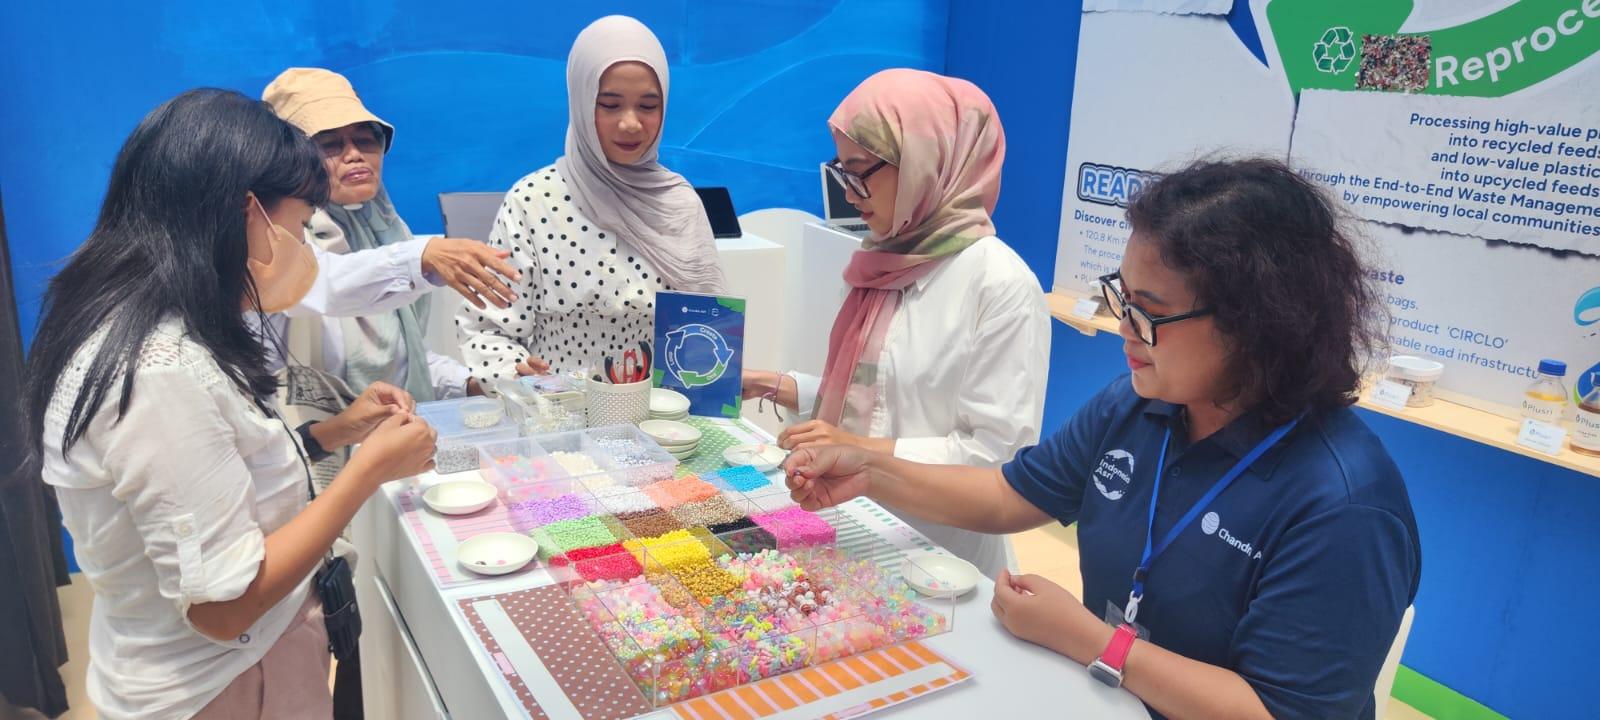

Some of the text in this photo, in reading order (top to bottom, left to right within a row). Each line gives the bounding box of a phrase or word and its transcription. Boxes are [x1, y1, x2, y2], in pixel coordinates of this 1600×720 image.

[1410, 113, 1490, 134] Processing
[1494, 118, 1582, 137] high-value
[1449, 133, 1478, 148] into
[1482, 140, 1553, 155] recycled
[1431, 152, 1600, 178] and low-value plastic
[1082, 171, 1148, 200] READ
[1440, 168, 1600, 197] into upcycled feeds
[1349, 175, 1370, 188] the
[1374, 178, 1454, 198] End-to-End
[1458, 187, 1506, 204] Waste
[1510, 194, 1600, 217] Manageme
[1074, 209, 1117, 227] Discover
[1343, 190, 1600, 236] by empowering local communities
[1084, 244, 1097, 254] The
[1107, 234, 1120, 244] Km
[1081, 261, 1102, 271] which
[1387, 293, 1418, 310] bags.
[1390, 315, 1440, 334] product
[1424, 345, 1454, 359] road
[1095, 466, 1114, 480] Asri
[1099, 458, 1130, 484] Indonesia
